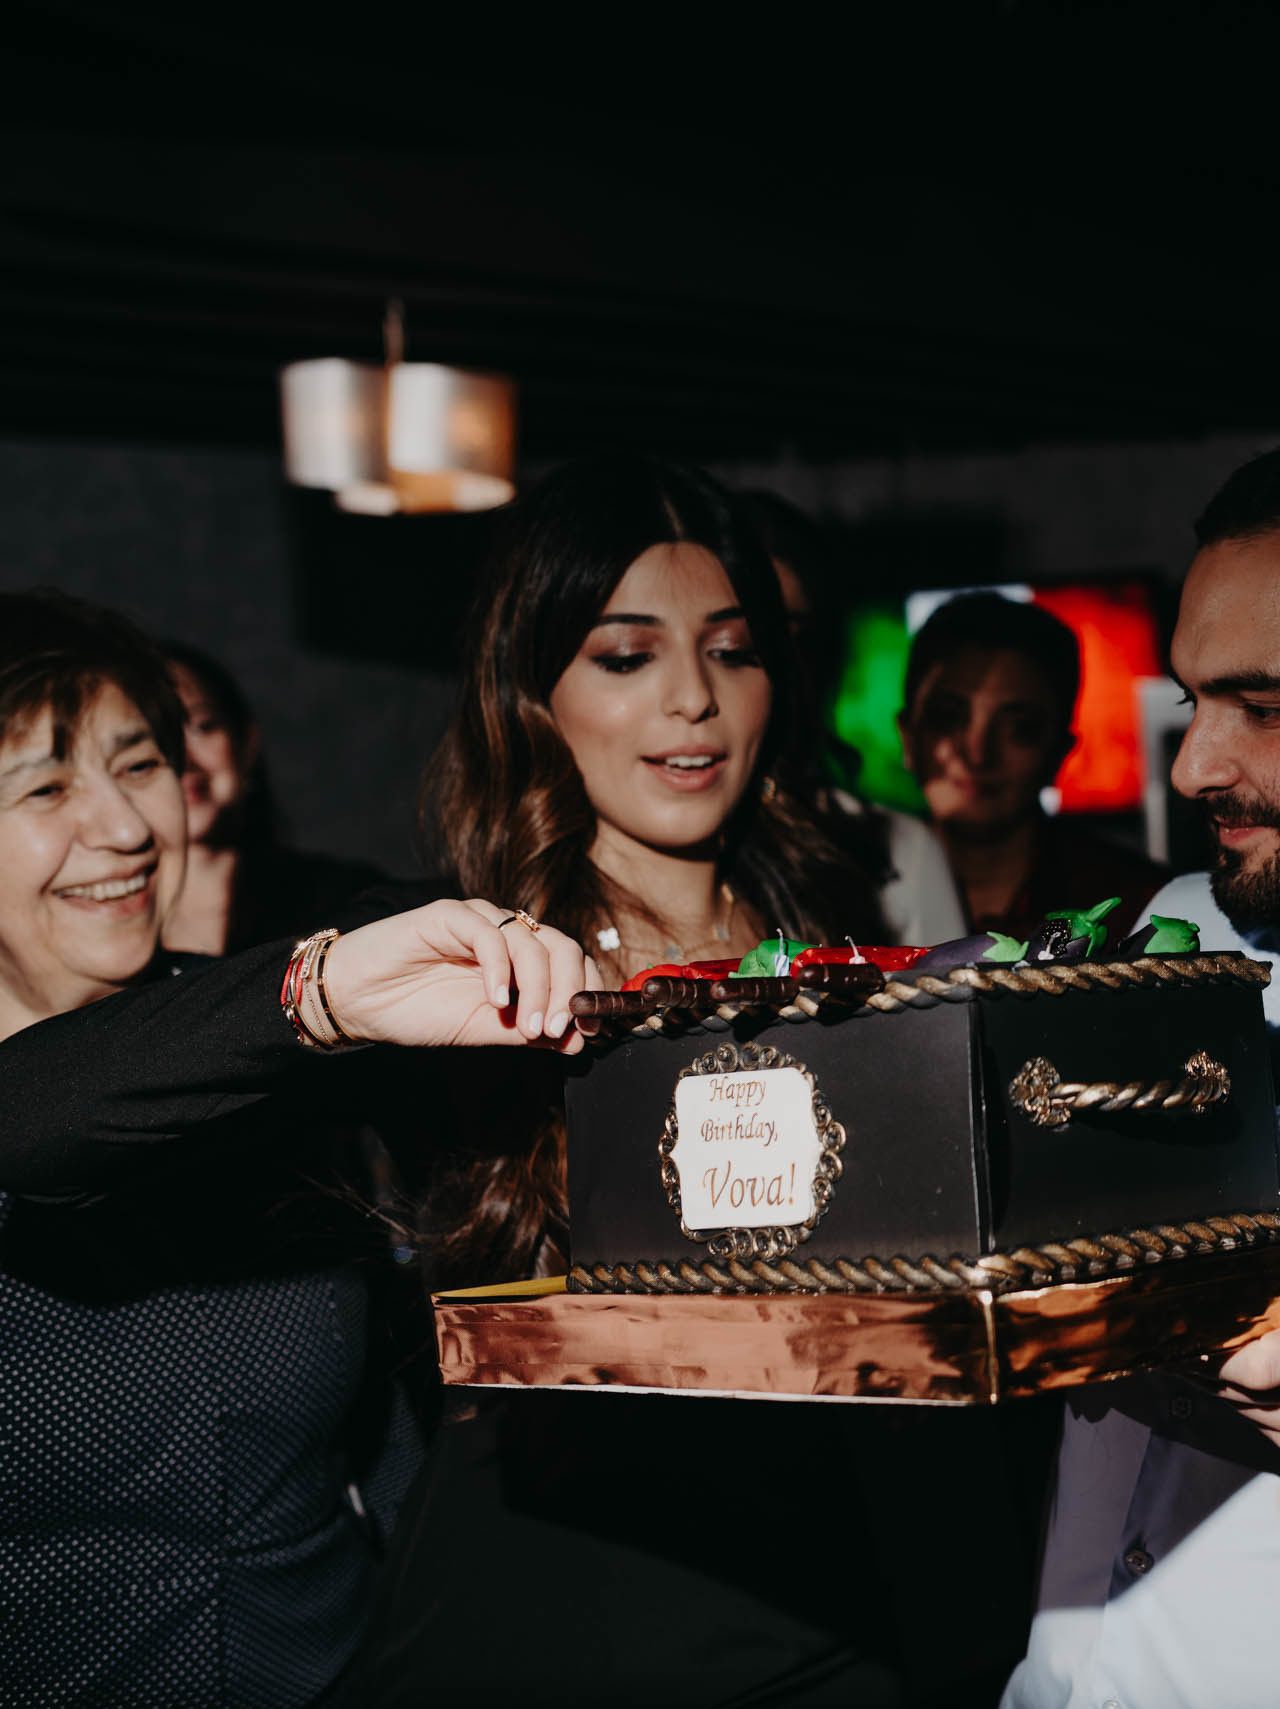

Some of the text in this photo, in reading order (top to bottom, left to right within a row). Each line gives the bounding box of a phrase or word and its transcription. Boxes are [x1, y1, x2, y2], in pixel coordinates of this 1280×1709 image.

[709, 1076, 766, 1107] Happy
[700, 1112, 778, 1147] Birthday,
[702, 1160, 795, 1208] Vova!
